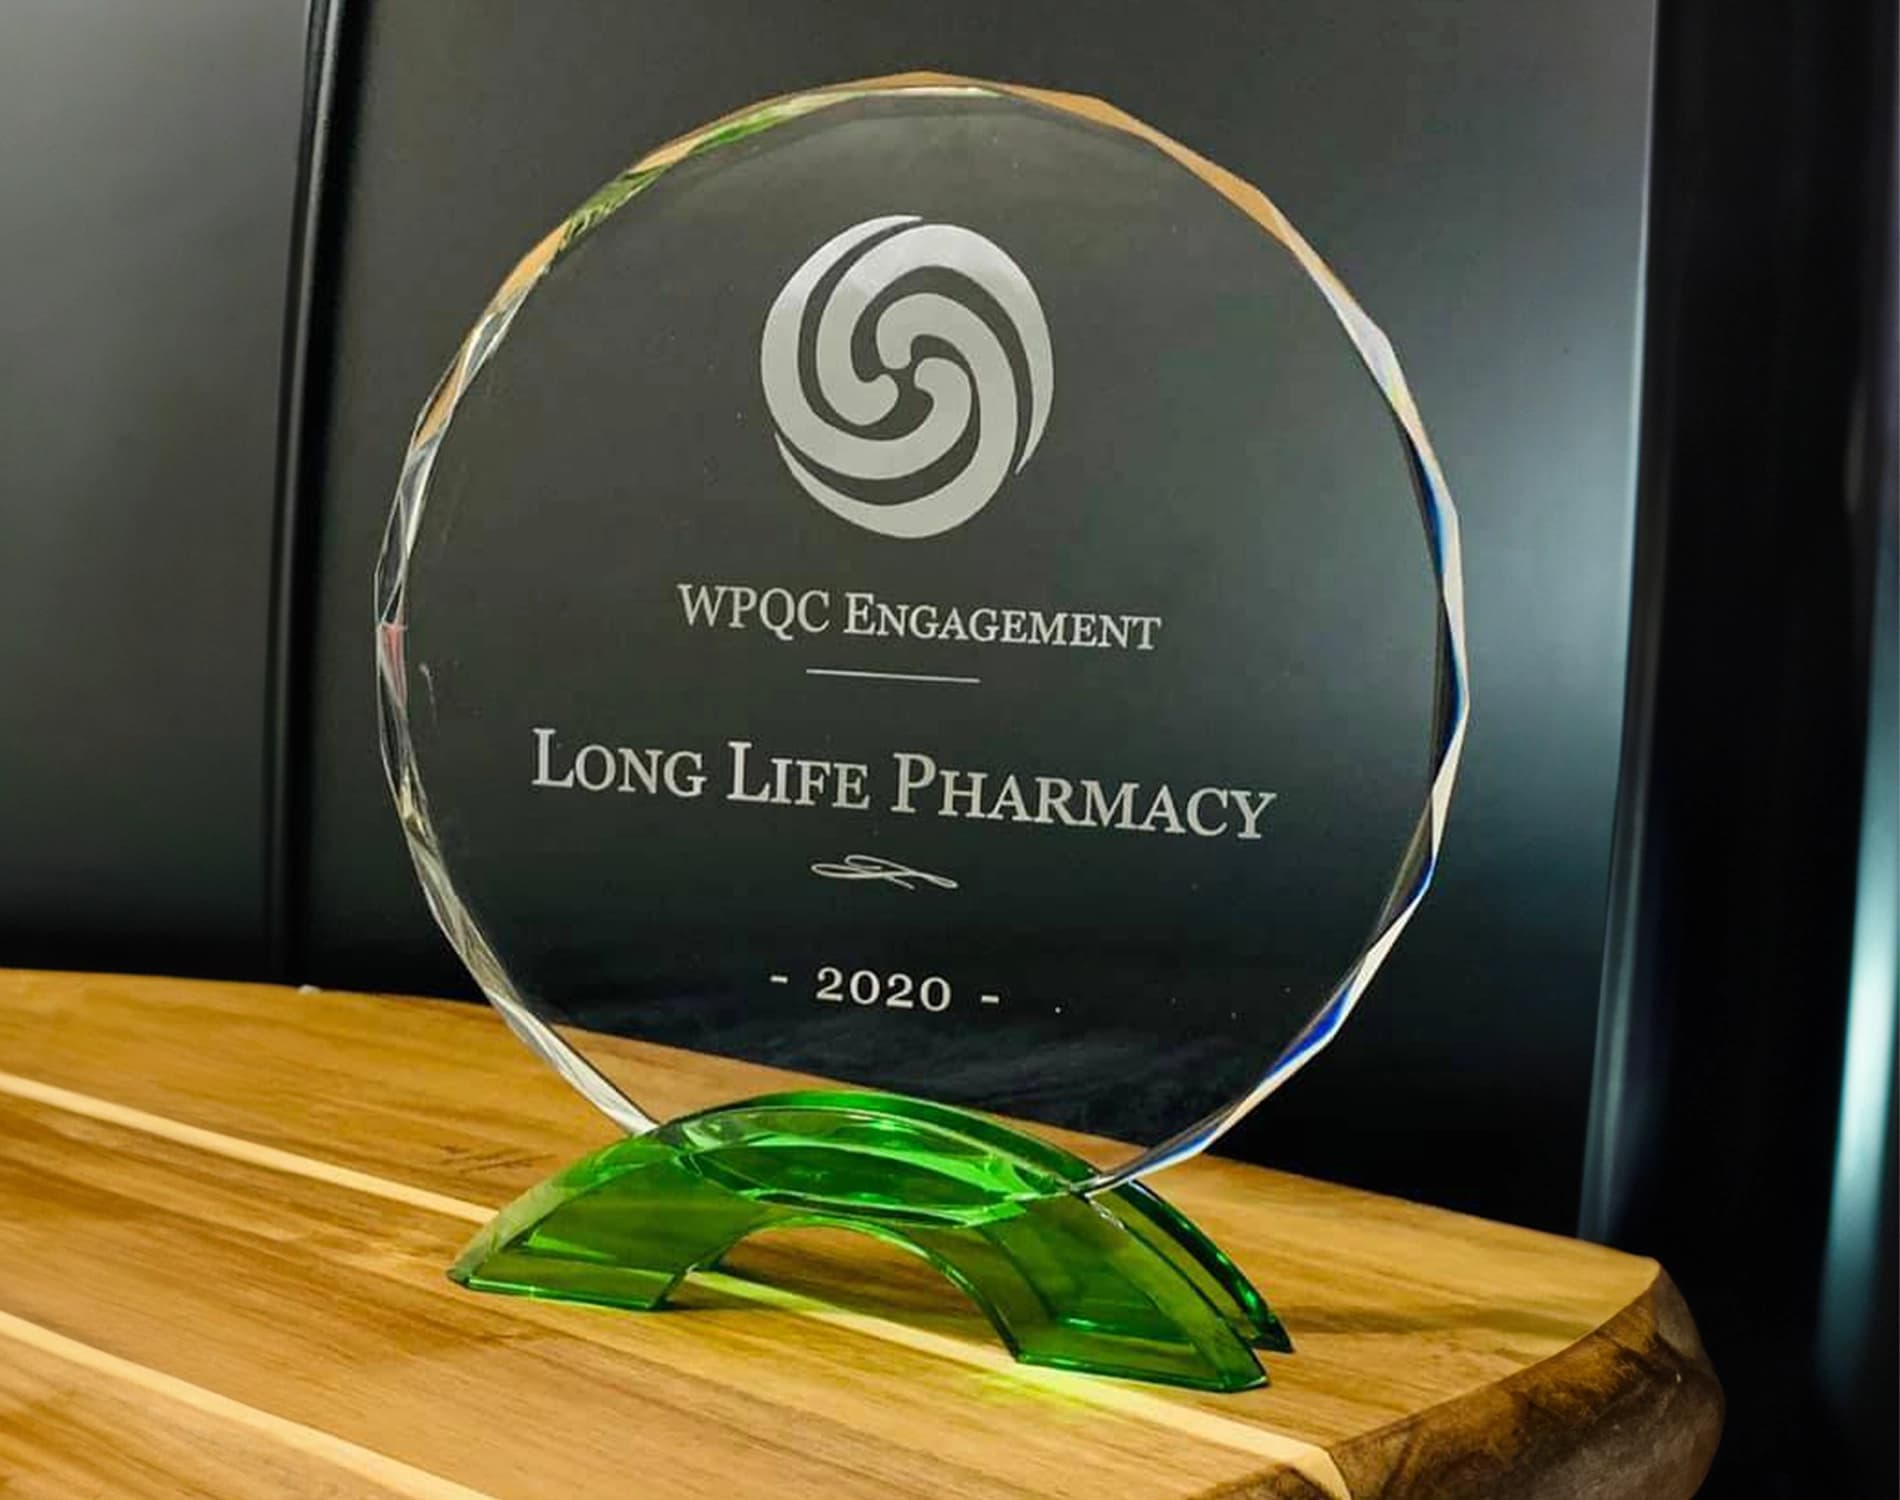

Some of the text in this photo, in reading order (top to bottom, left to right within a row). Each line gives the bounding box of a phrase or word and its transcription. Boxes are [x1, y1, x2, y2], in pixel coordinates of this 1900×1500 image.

[676, 583, 1162, 651] WPQC ENGAGEMENT
[531, 727, 1278, 841] LONG LIFE PHARMACY
[815, 966, 952, 1012] 2020
